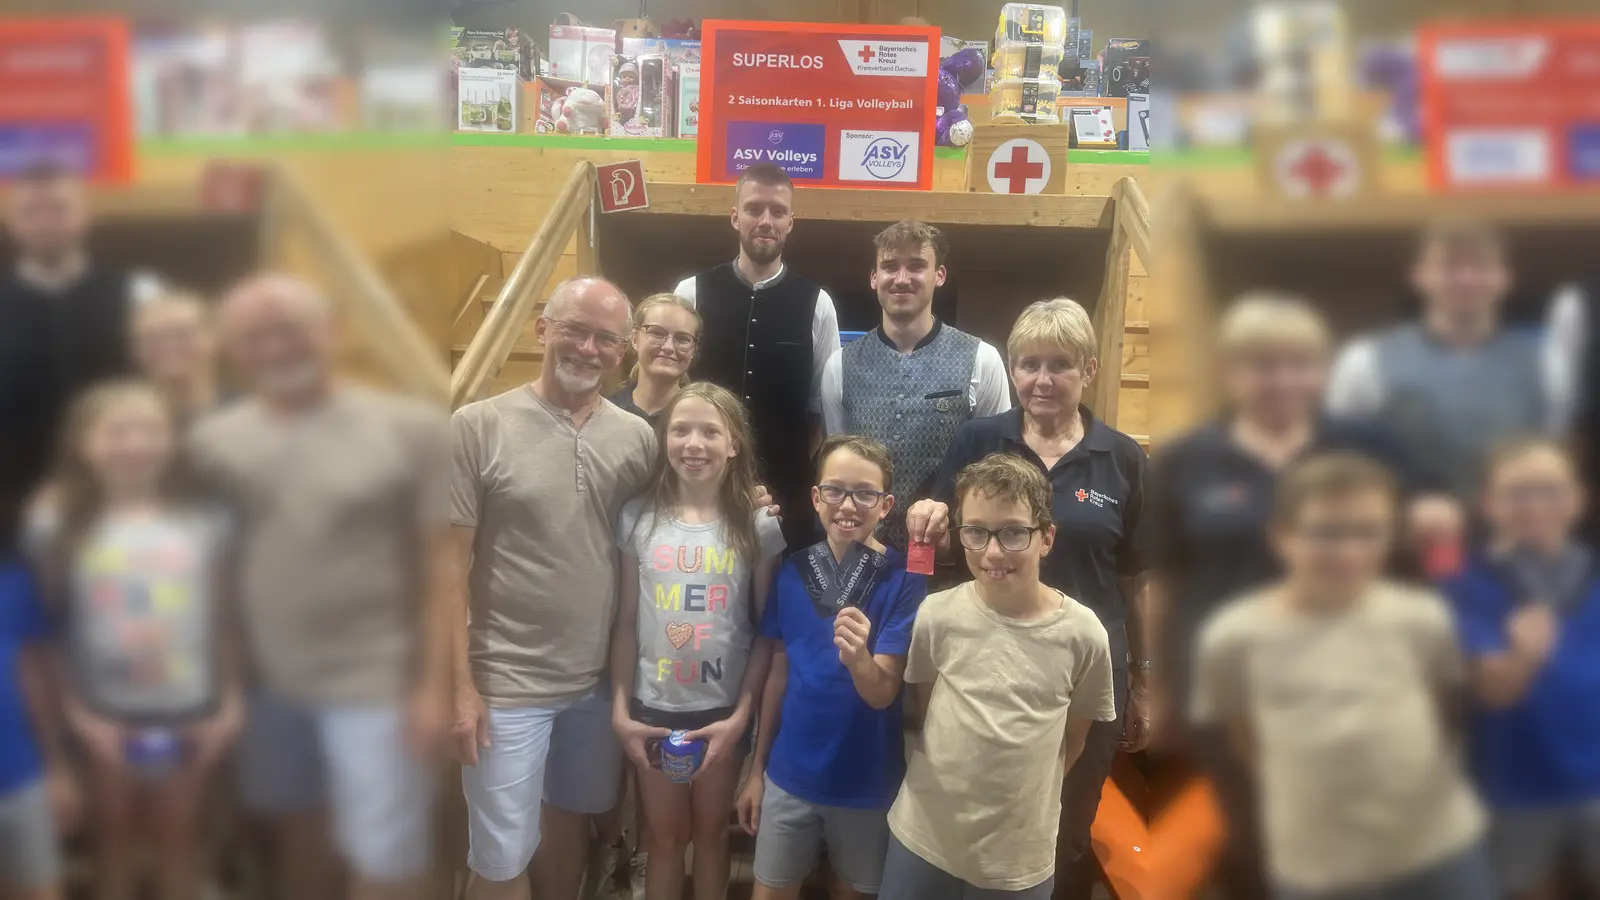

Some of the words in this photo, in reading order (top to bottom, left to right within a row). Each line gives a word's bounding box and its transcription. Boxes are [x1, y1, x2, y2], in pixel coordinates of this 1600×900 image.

[879, 45, 917, 53] Bayerisches
[732, 52, 824, 70] SUPERLOS
[728, 95, 735, 105] 2
[738, 96, 813, 107] Saisonkarten
[817, 98, 826, 107] 1.
[829, 98, 853, 109] Liga
[857, 99, 913, 111] Volleyball
[845, 132, 875, 140] Sponsor:
[733, 148, 764, 160] ASV
[766, 149, 817, 164] Volleys
[860, 144, 910, 166] ASV
[868, 160, 902, 168] VOLLEYS
[787, 165, 814, 173] erleben
[653, 544, 734, 574] SUM
[808, 554, 828, 591] onkarte
[836, 553, 870, 606] Saisonkarte
[654, 582, 728, 612] MER
[657, 656, 723, 684] FUN
